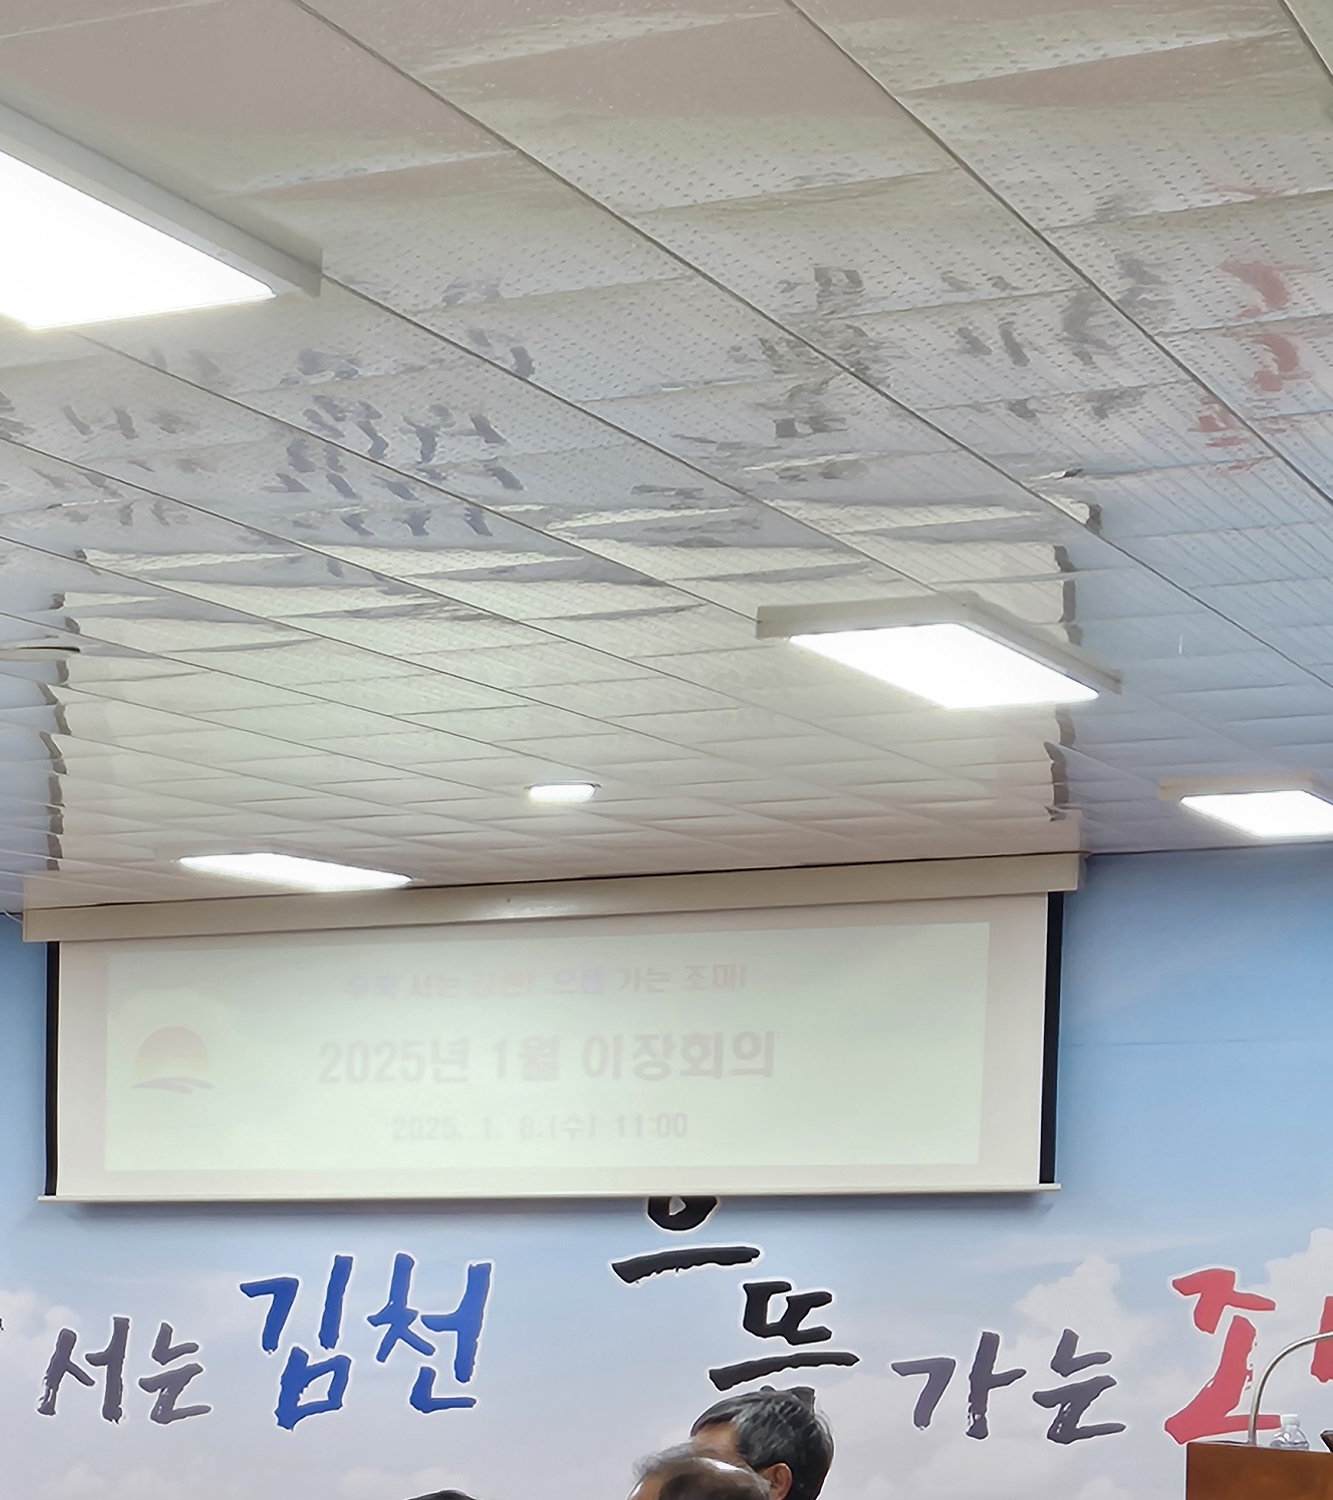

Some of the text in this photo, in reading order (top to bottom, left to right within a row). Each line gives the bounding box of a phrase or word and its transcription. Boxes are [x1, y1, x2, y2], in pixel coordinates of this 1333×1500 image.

[617, 965, 672, 994] 가는
[317, 1030, 775, 1085] 2025년 1월 이장회의
[614, 1112, 688, 1138] 11:00
[37, 1316, 212, 1425] 서는
[239, 1252, 492, 1431] 김천
[891, 1328, 1127, 1445] 가는
[1164, 1268, 1333, 1446] 조
